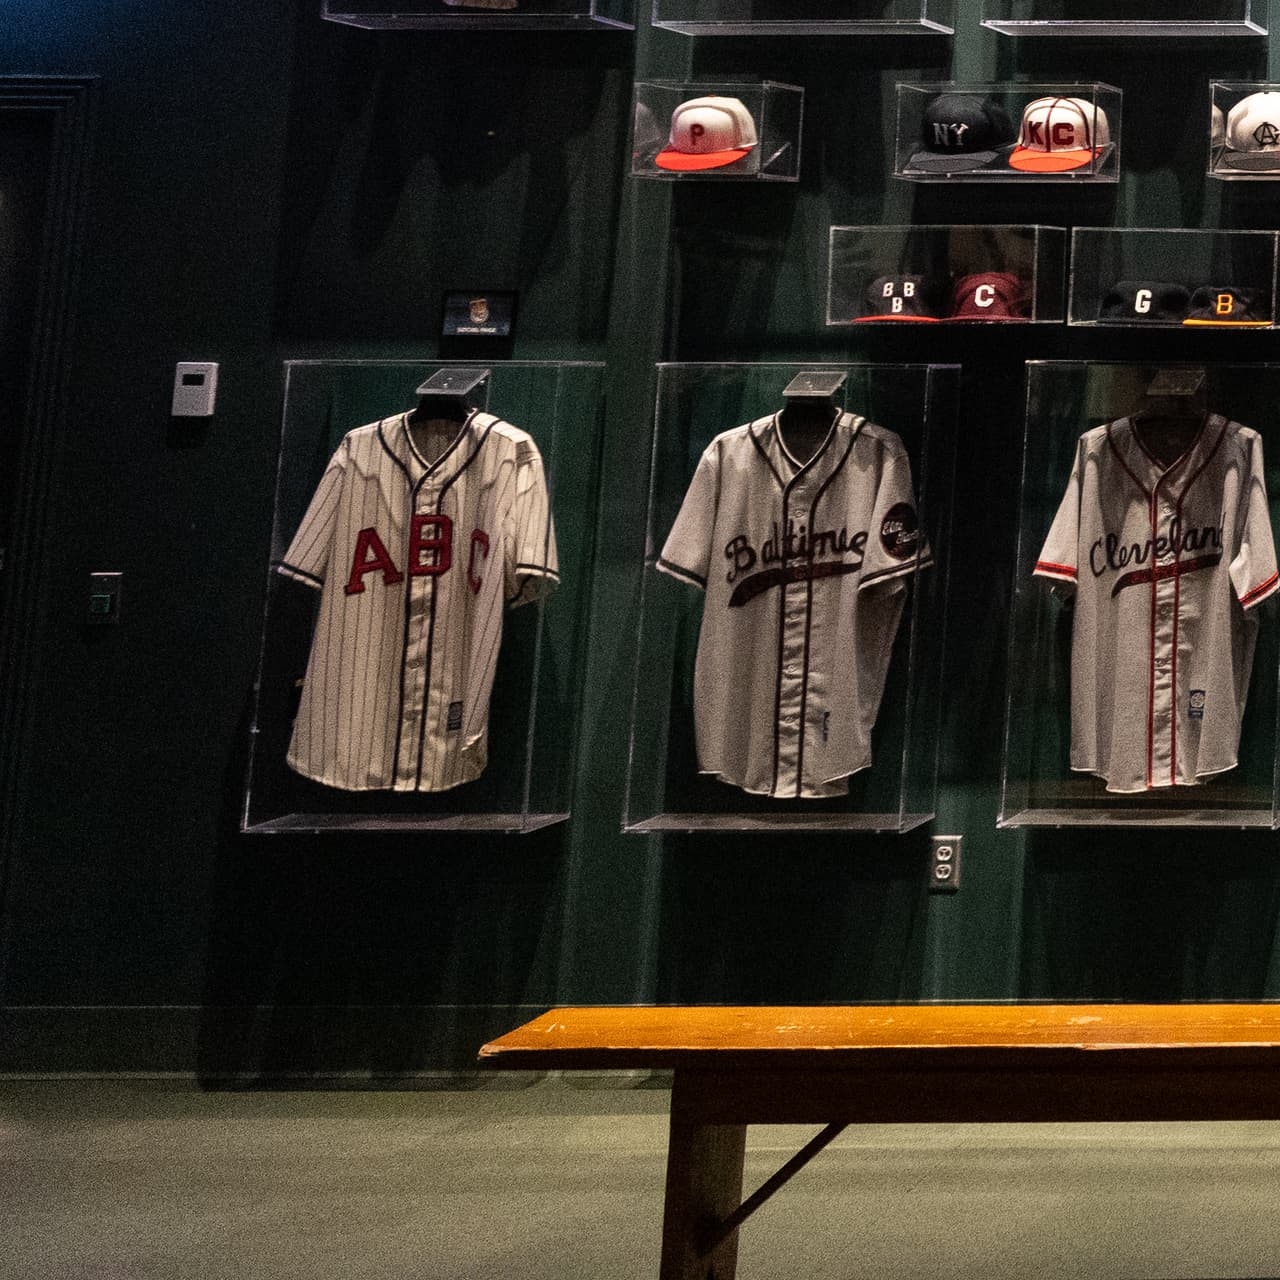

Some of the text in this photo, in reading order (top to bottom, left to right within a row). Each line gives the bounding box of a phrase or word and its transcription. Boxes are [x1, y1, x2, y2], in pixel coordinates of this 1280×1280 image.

[690, 124, 704, 145] P
[932, 122, 968, 146] NY
[974, 284, 995, 307] C
[1134, 289, 1152, 313] G
[1216, 293, 1234, 316] B
